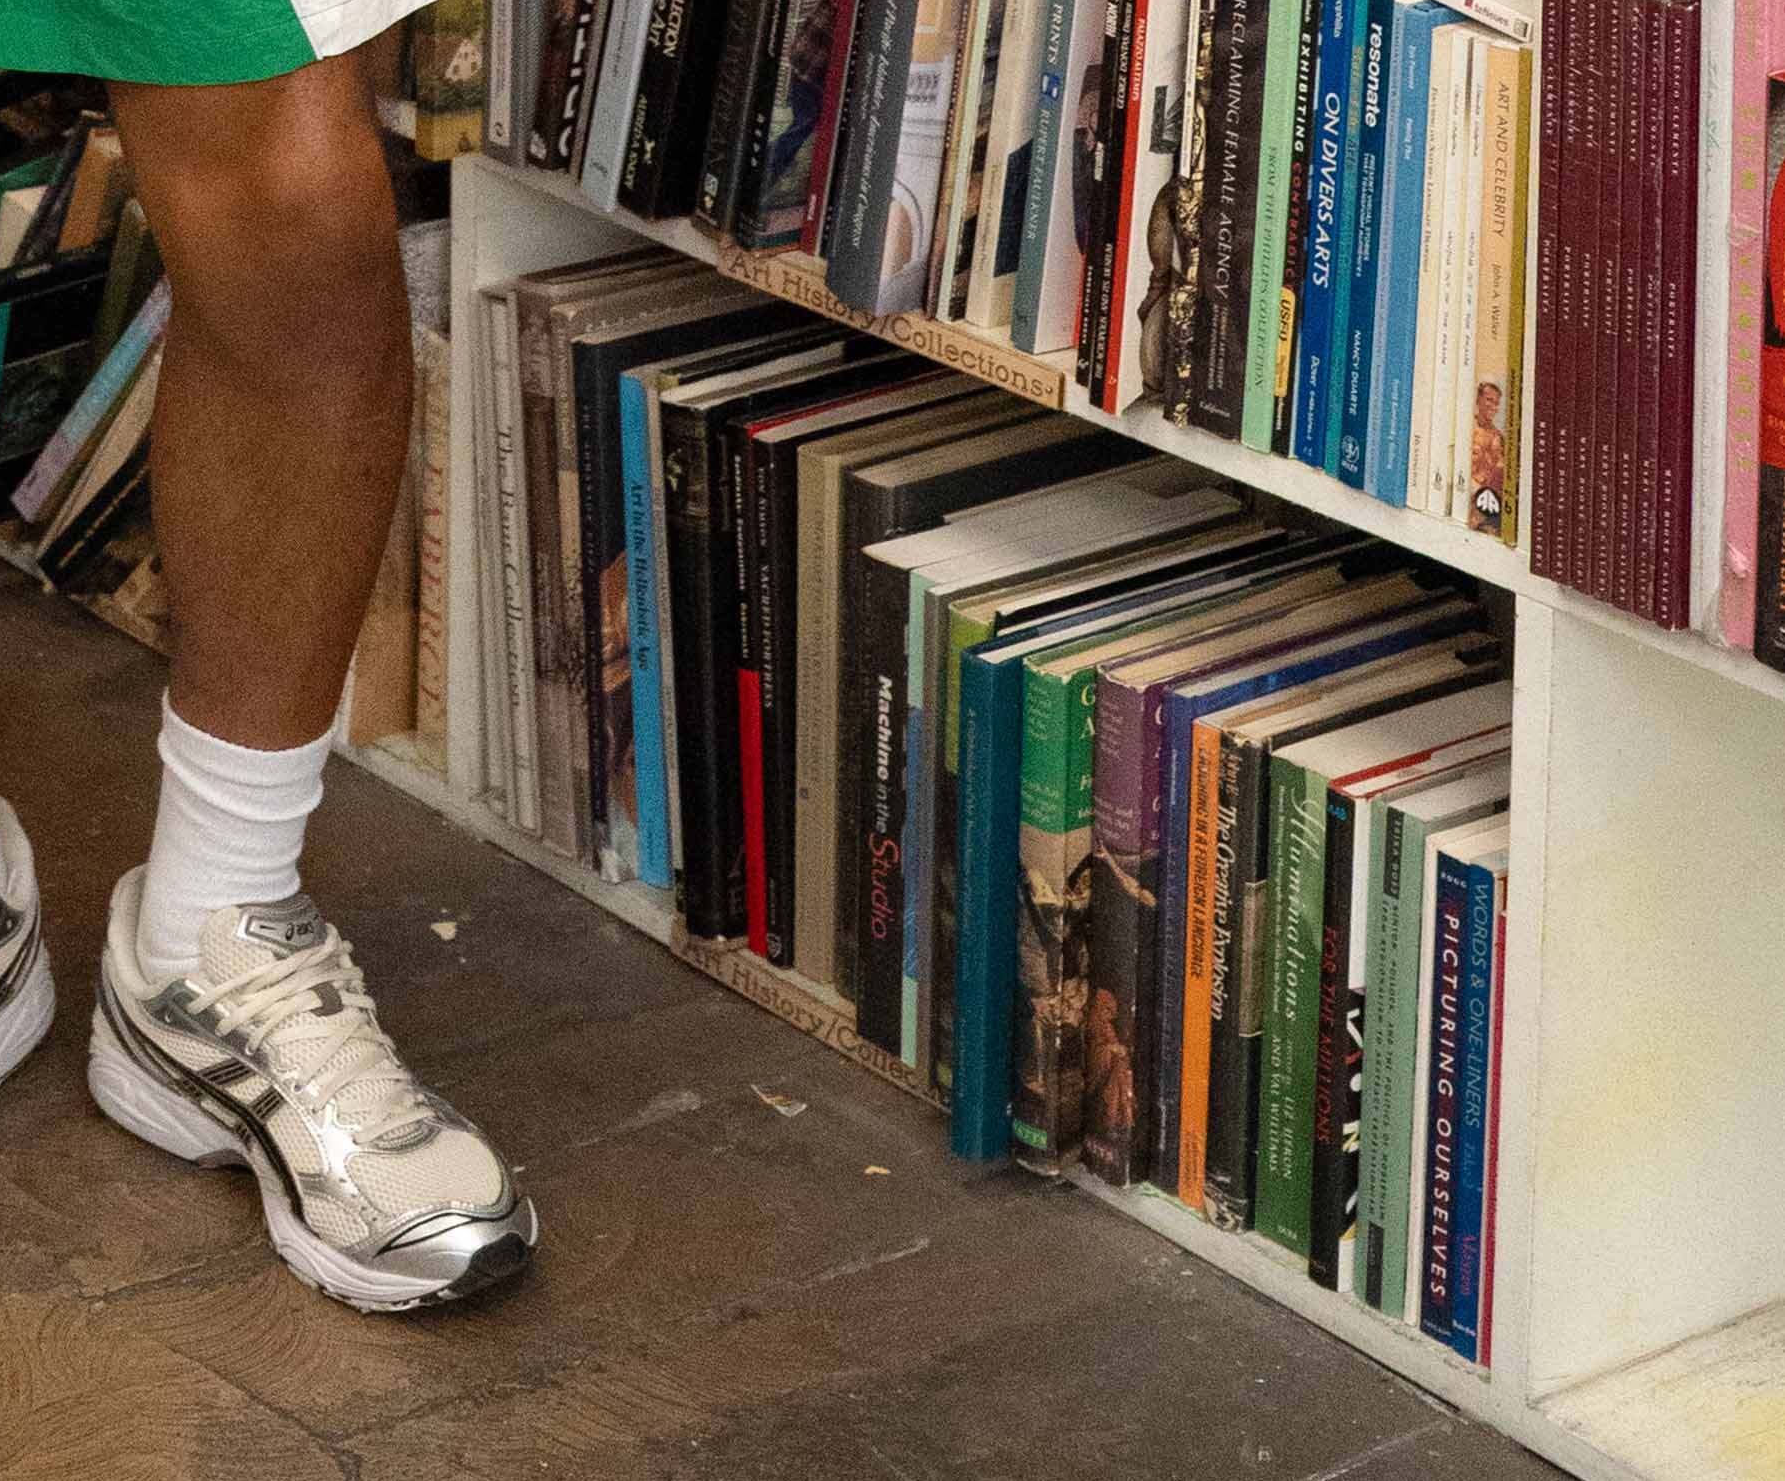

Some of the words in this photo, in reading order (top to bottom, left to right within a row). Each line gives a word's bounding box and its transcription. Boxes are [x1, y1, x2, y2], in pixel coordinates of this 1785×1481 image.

[1045, 4, 1066, 65] PRINTS
[1363, 21, 1386, 127] resonate
[1293, 32, 1312, 152] EXHIBITING
[1322, 91, 1342, 132] ON
[1495, 80, 1511, 112] ART
[1219, 130, 1241, 205] FEMALE
[1494, 114, 1510, 153] AND
[1316, 136, 1339, 218] DIVERS
[1492, 156, 1509, 238] CELEBRITY
[1213, 212, 1235, 298] AGENCY
[1311, 221, 1336, 287] ARTS
[875, 675, 893, 781] Machine
[875, 783, 890, 799] in
[875, 799, 891, 834] the
[1216, 804, 1238, 842] The
[868, 833, 902, 940] Studio
[1214, 847, 1236, 924] Creative
[1211, 927, 1234, 1021] Explosion
[1438, 914, 1460, 1098] PICTURING
[1429, 1116, 1452, 1298] OURSELVES
